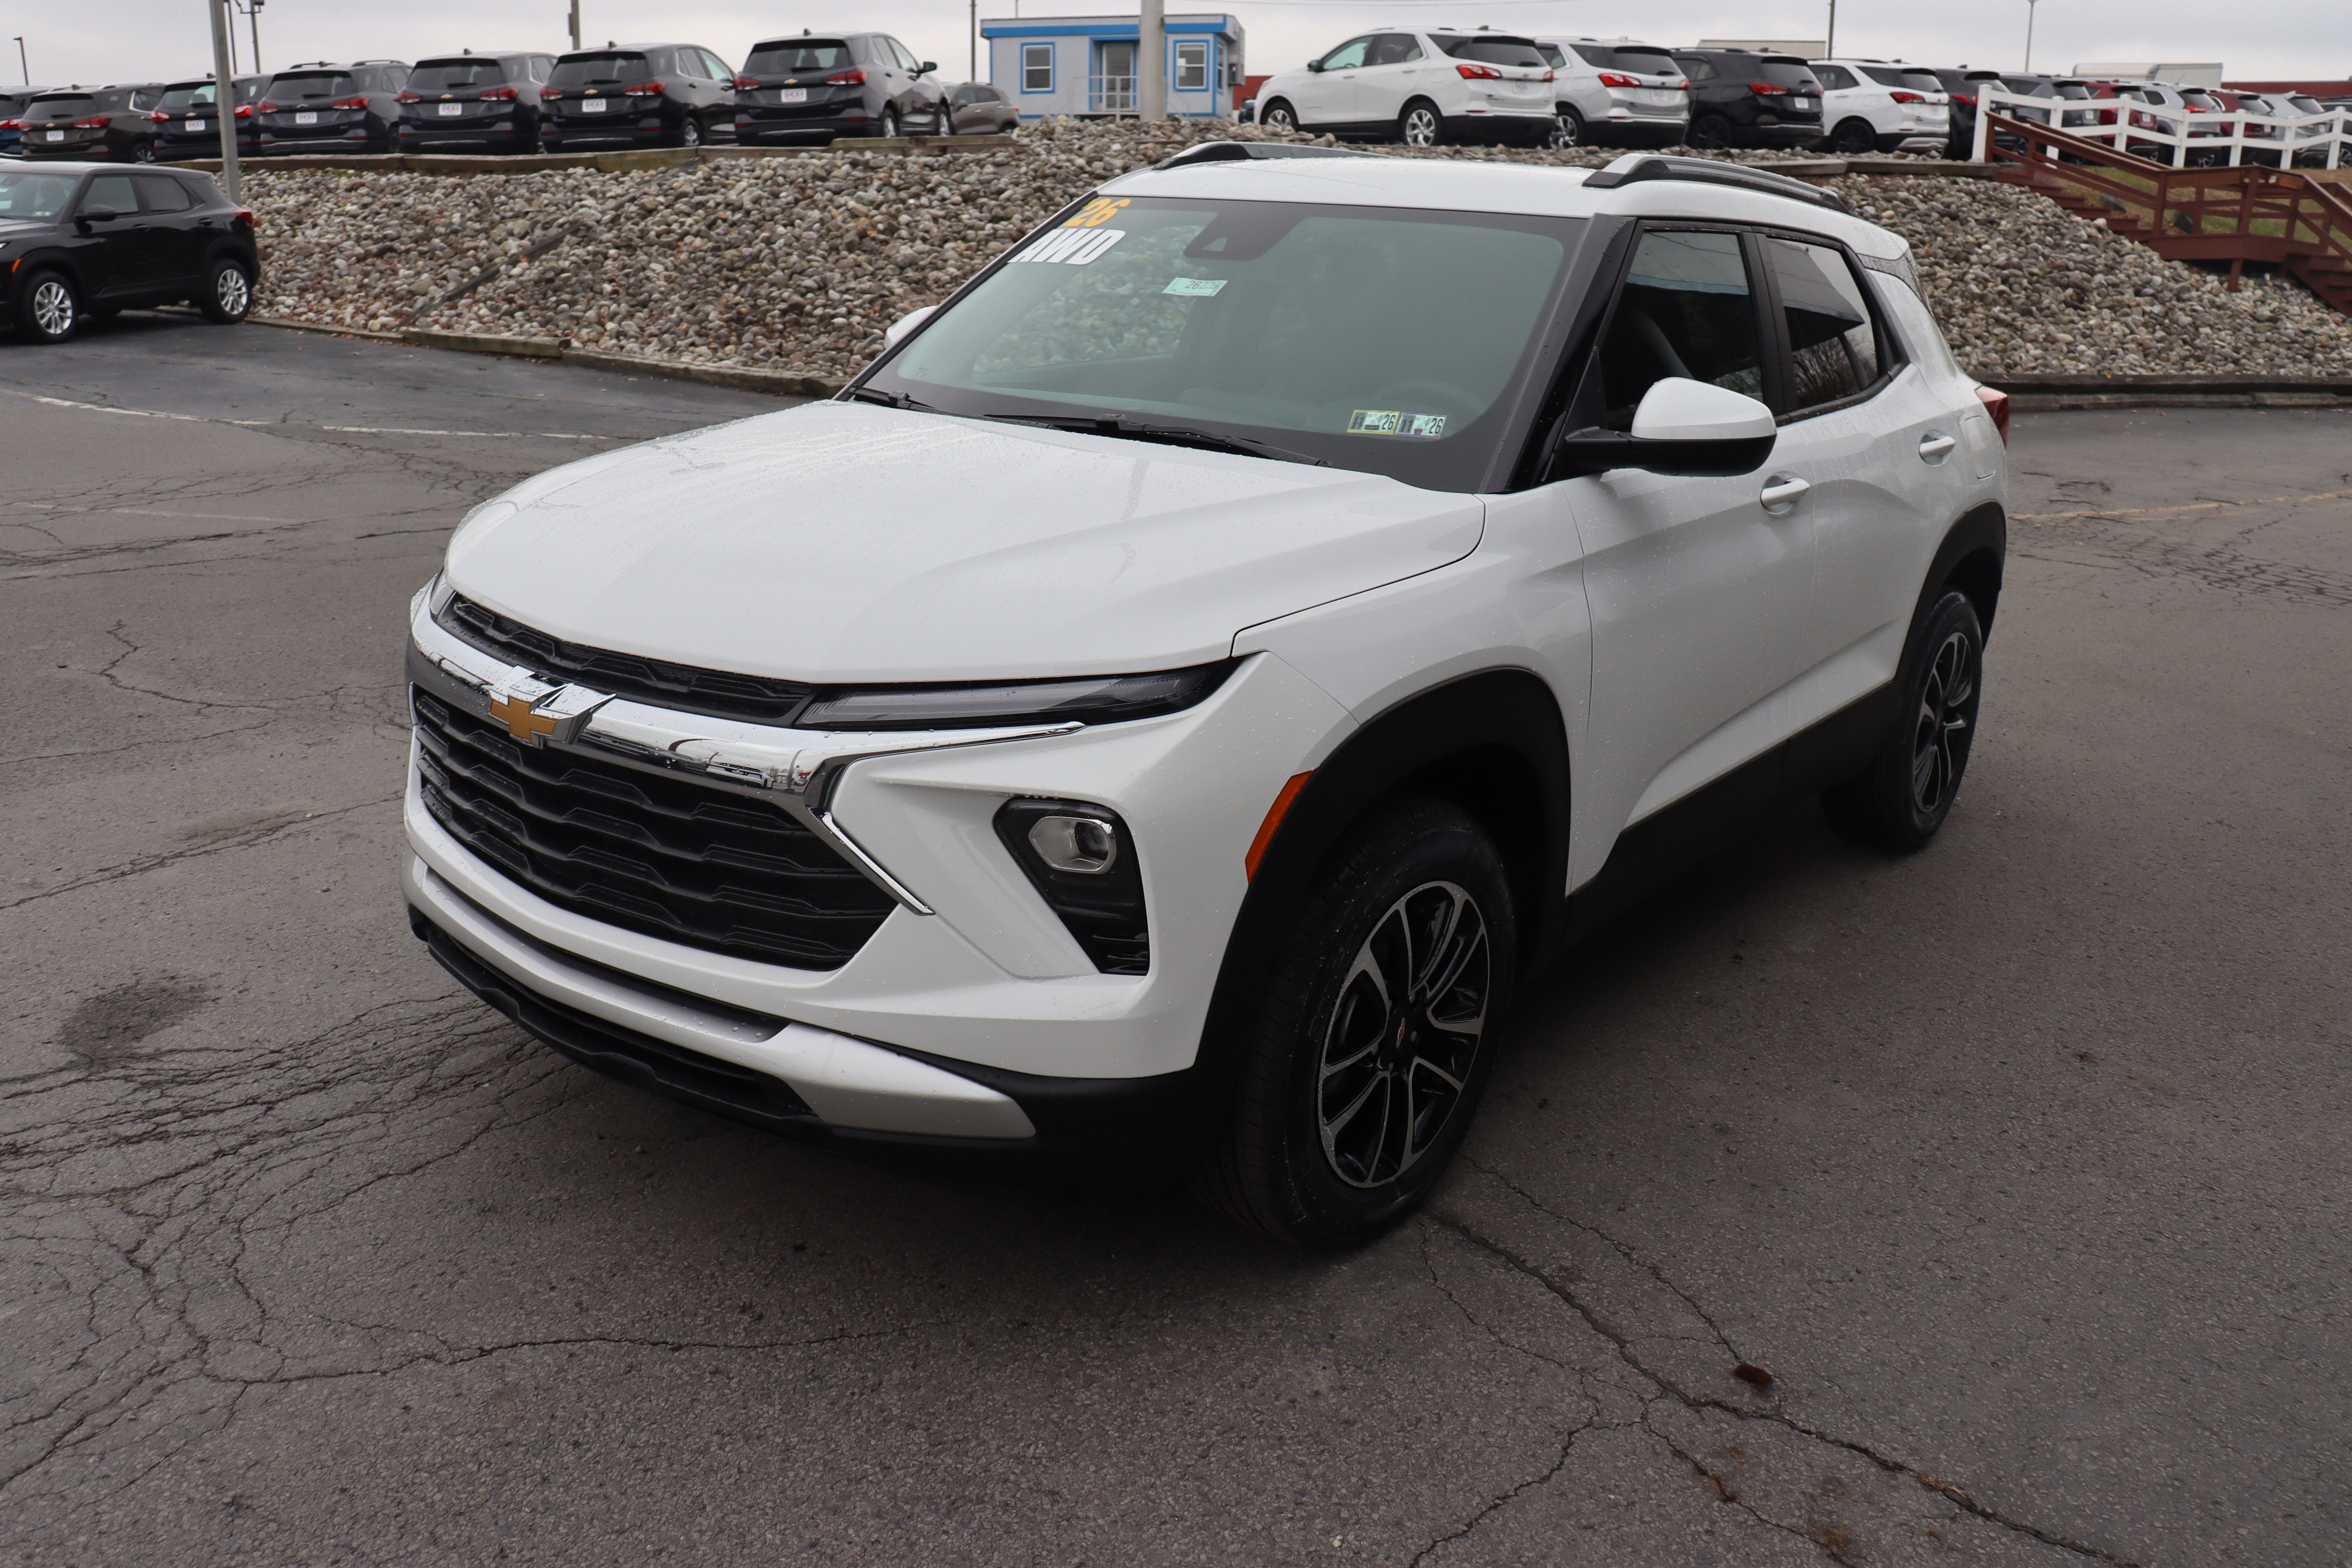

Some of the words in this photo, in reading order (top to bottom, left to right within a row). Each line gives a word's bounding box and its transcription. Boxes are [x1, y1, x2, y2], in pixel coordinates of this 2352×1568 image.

[1007, 228, 1126, 265] AWD
[1382, 414, 1396, 430] 26
[1429, 418, 1443, 434] 26
